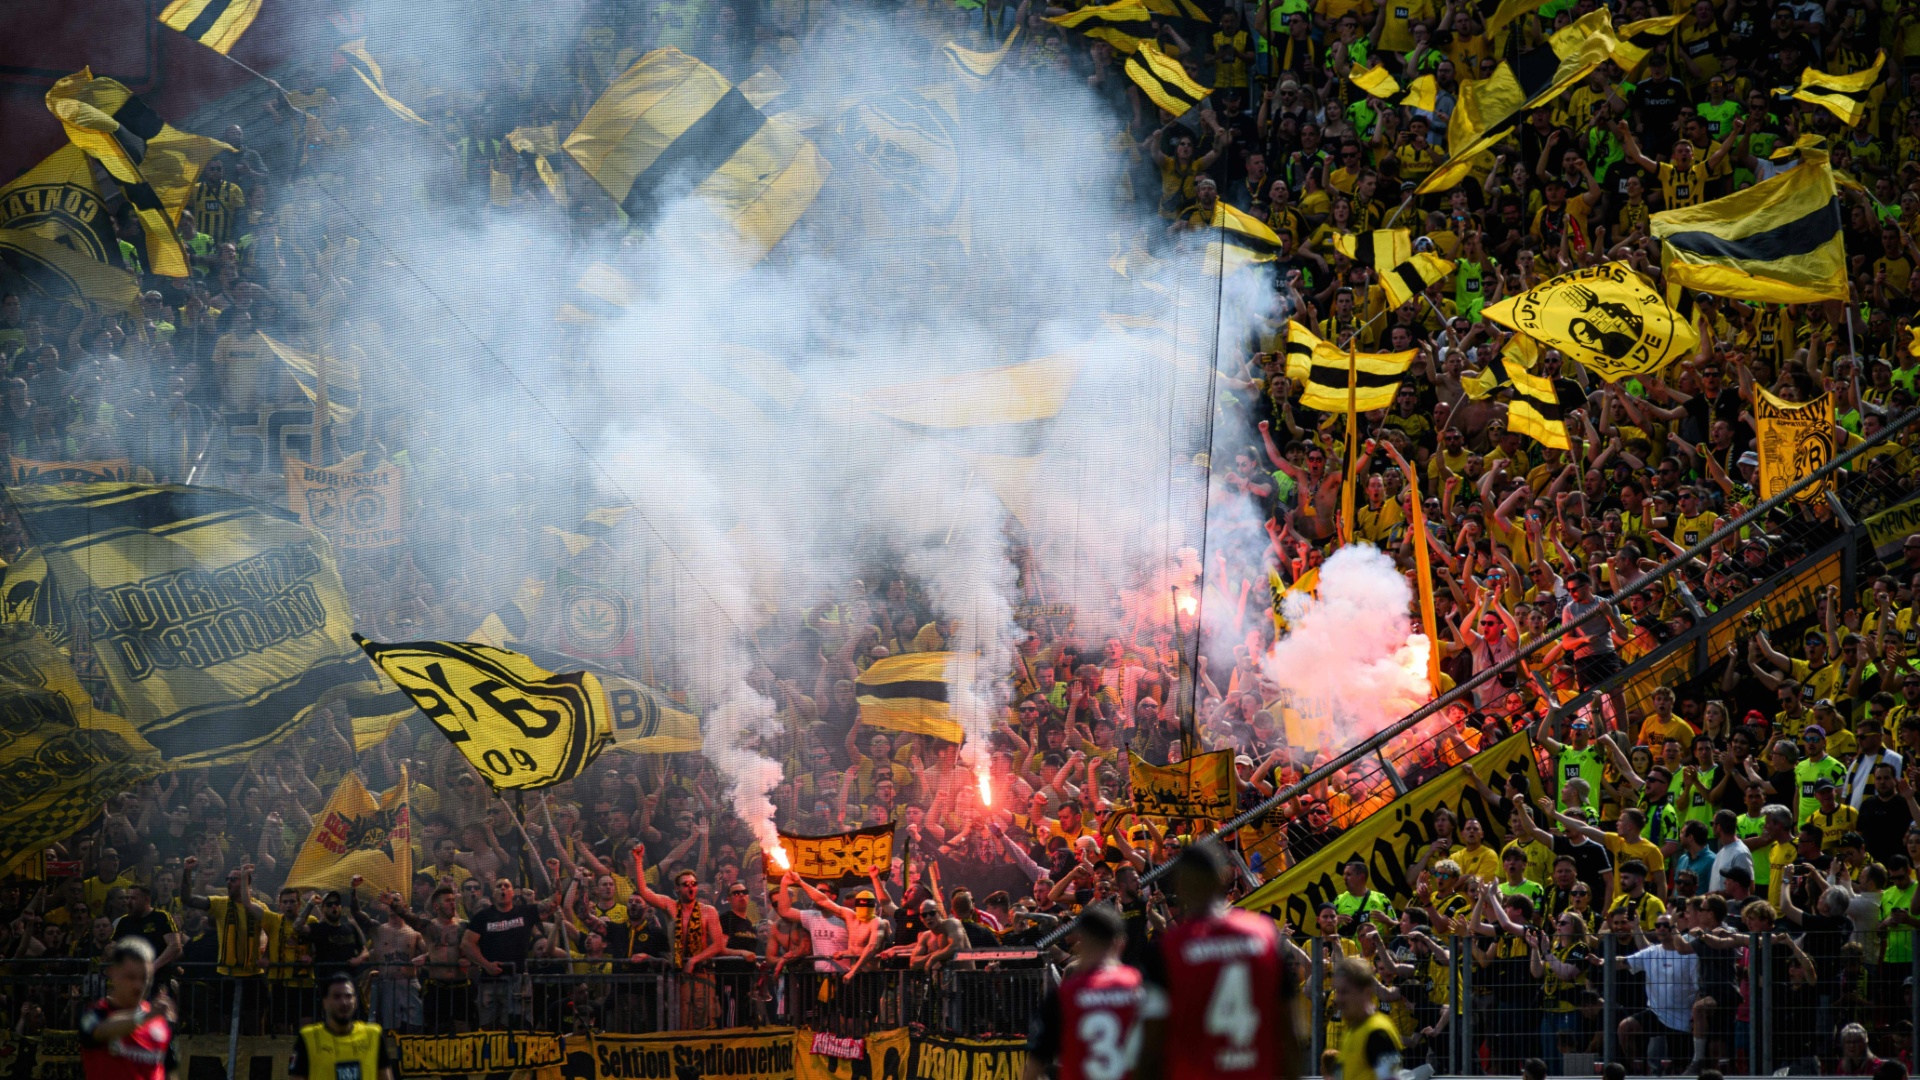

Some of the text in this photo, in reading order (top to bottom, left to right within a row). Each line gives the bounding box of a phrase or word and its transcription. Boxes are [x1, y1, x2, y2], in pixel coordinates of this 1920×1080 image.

[1677, 187, 1688, 196] 1&1
[1762, 334, 1774, 342] 1&1
[304, 467, 390, 487] BORUSSIA
[1685, 534, 1697, 543] 1&1
[483, 747, 537, 776] 09
[1565, 767, 1579, 777] 1&1
[1206, 963, 1260, 1046] 4
[597, 1043, 671, 1079] Sektion
[674, 1039, 794, 1079] Stadionverbot
[916, 1041, 1031, 1080] HOOLIGAN
